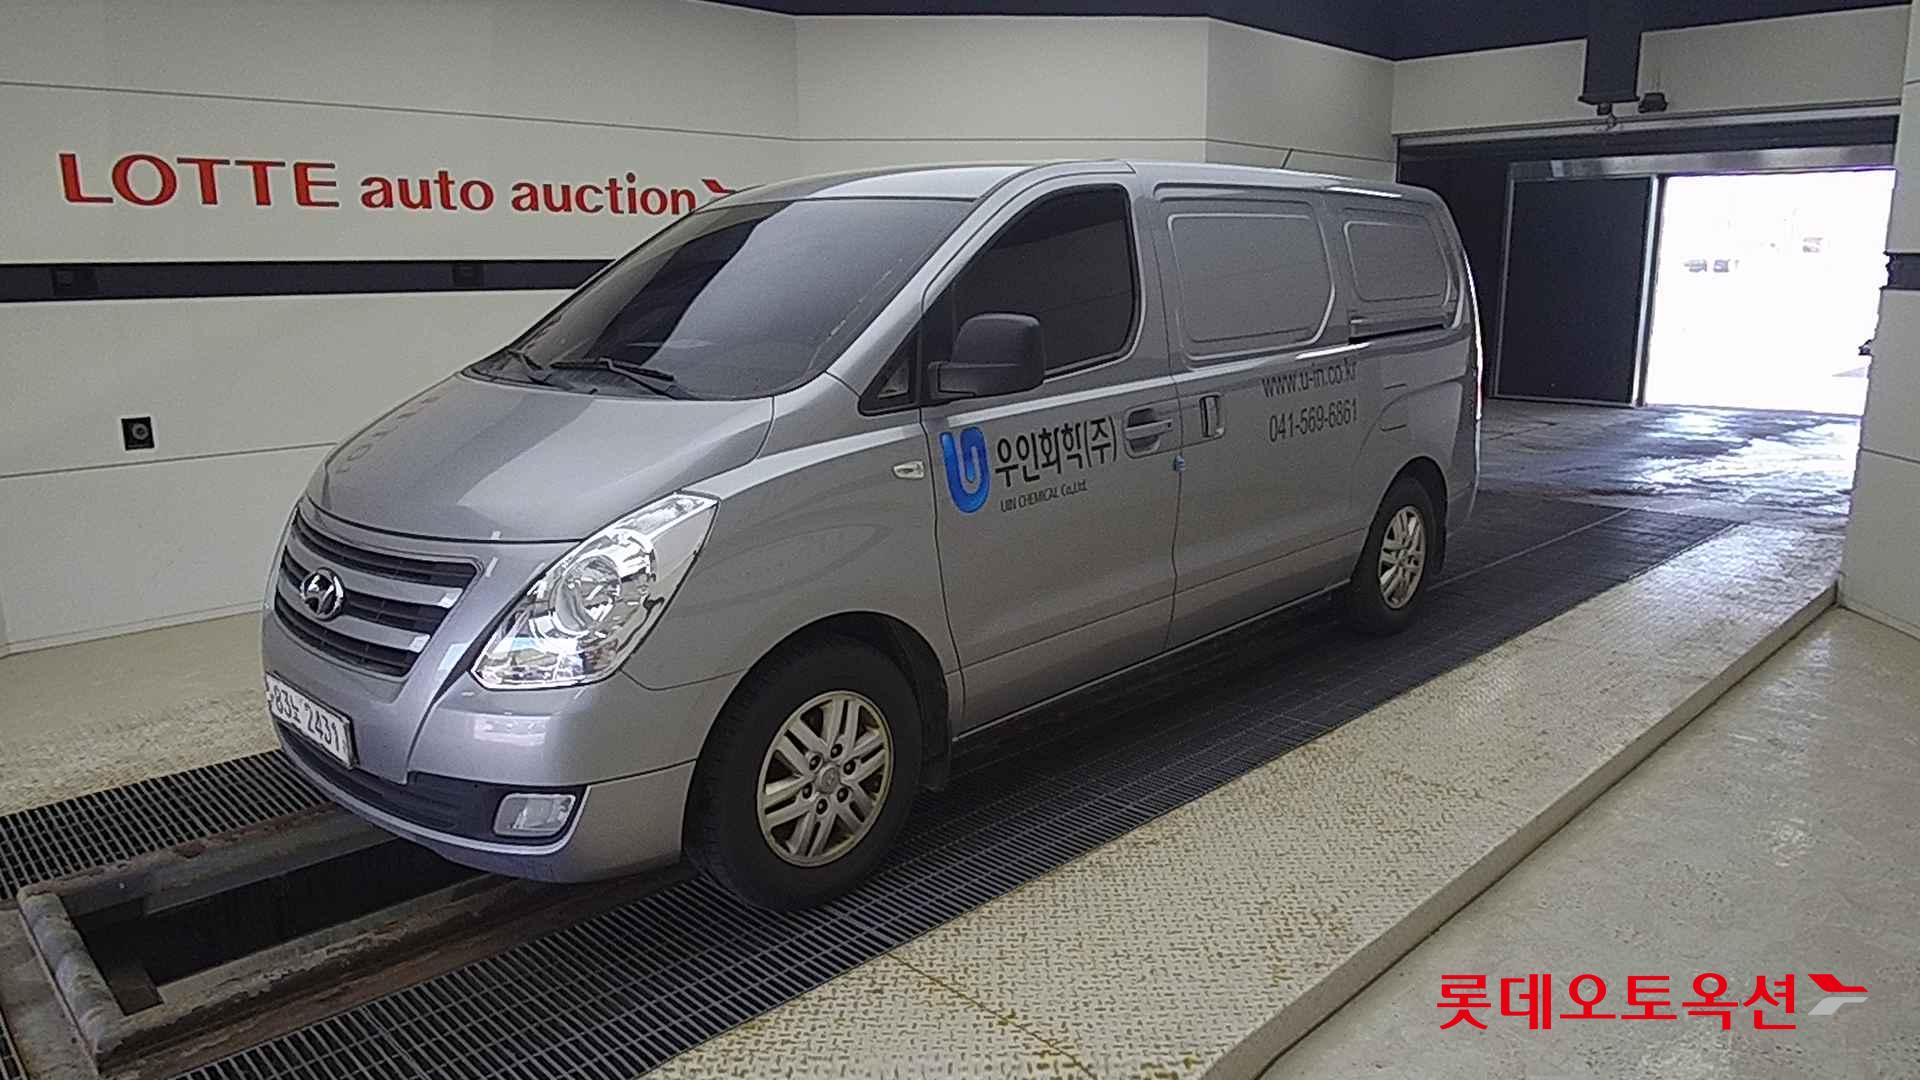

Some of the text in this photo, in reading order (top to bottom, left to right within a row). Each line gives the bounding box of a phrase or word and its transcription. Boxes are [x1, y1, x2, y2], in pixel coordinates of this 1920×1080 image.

[59, 153, 697, 215] LOTTE auto auction
[1262, 357, 1357, 397] www.u-in.co.kr
[1270, 398, 1357, 442] 041-569-6861
[303, 702, 340, 752] 2431
